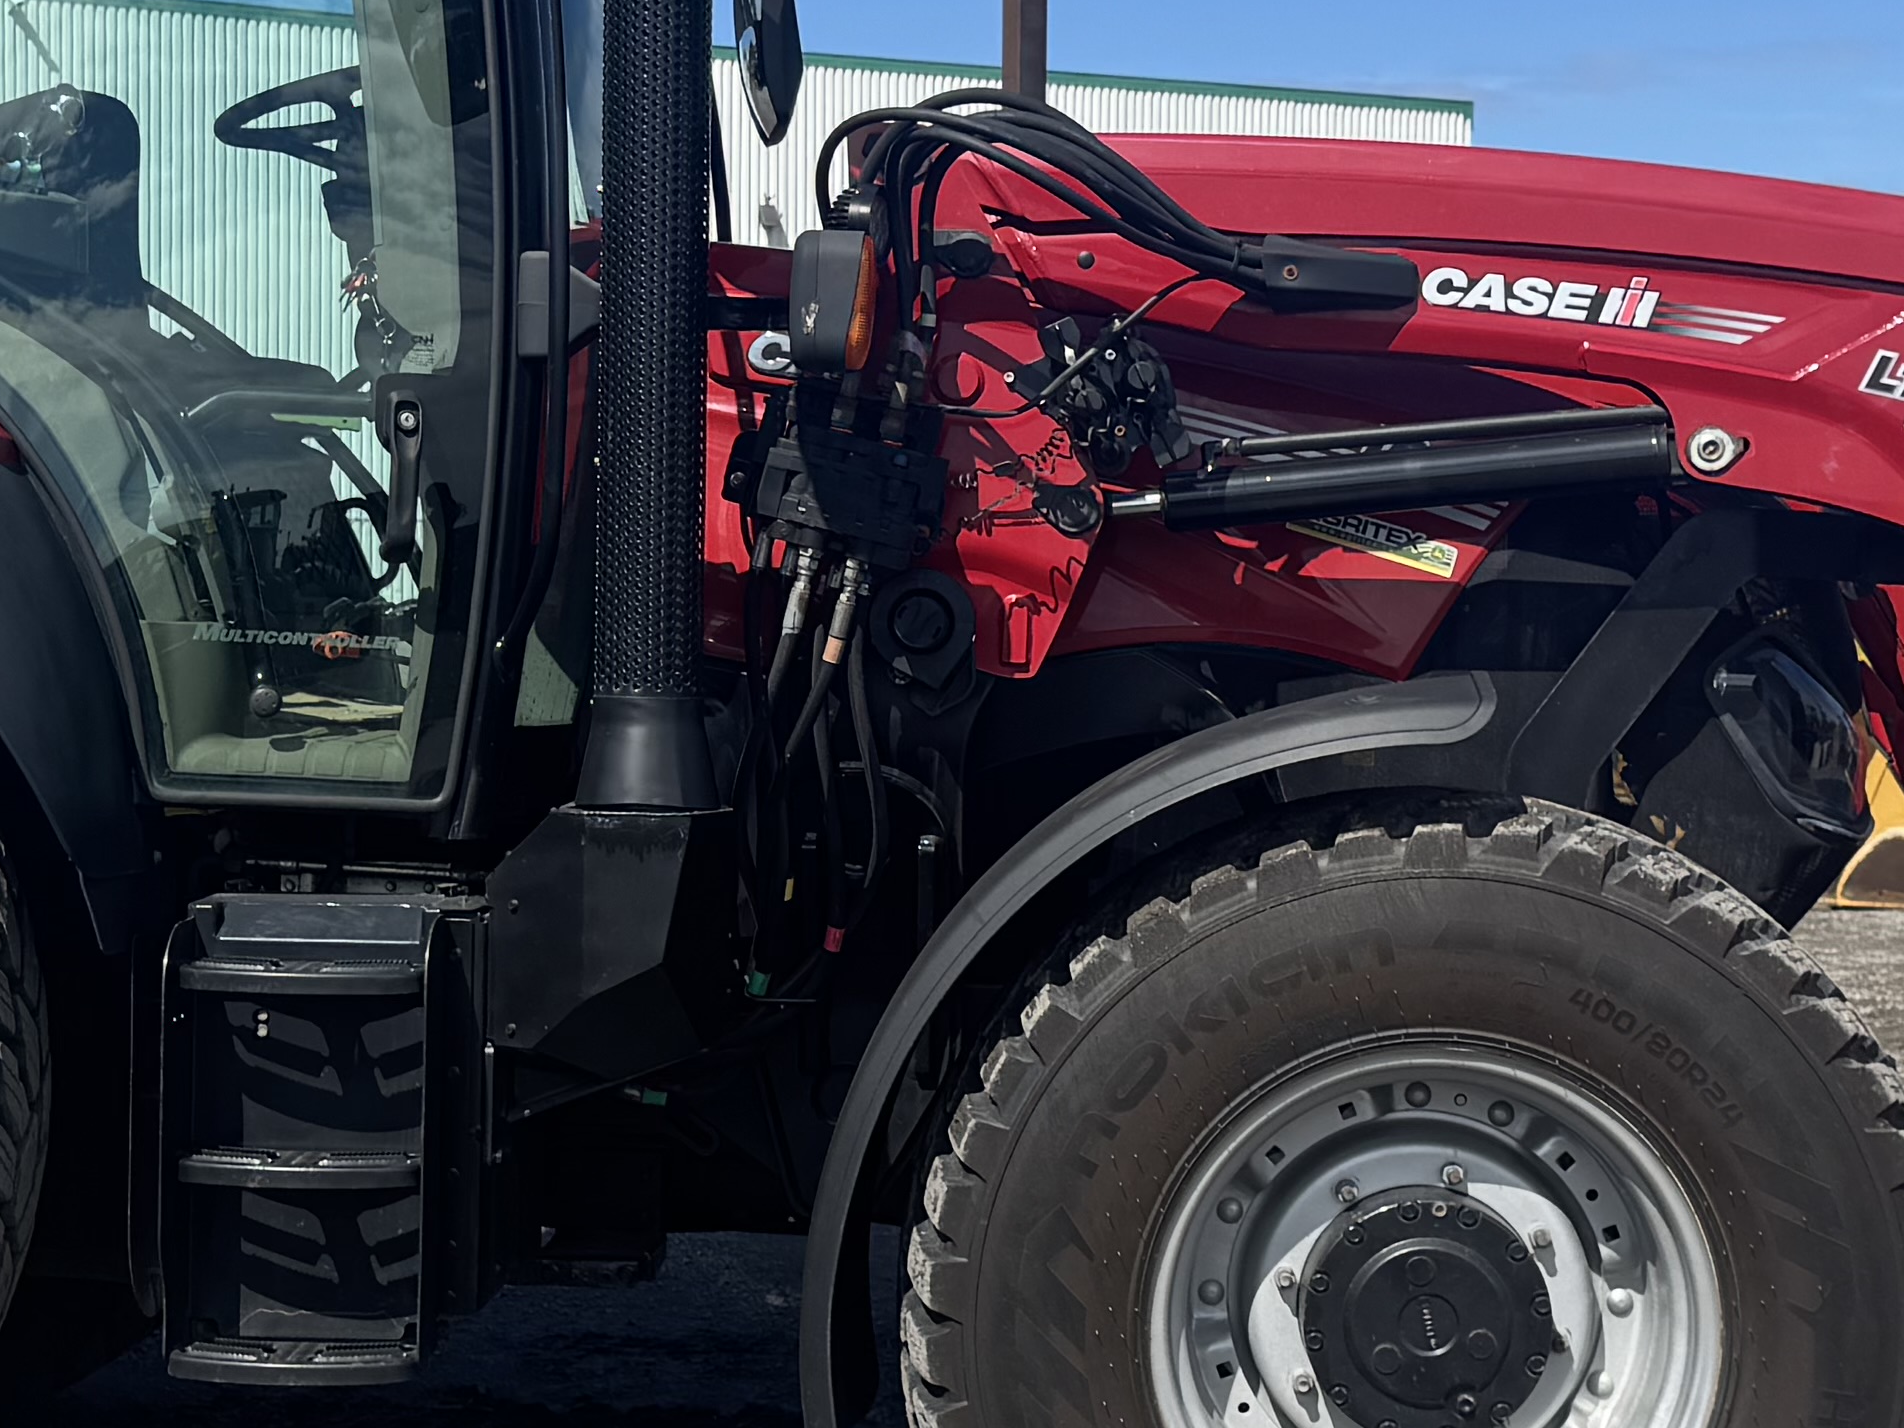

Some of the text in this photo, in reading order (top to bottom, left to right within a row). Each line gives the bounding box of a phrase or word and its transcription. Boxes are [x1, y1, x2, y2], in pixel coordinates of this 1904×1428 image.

[1421, 266, 1598, 322] CASE
[1314, 514, 1428, 552] GRITEX
[1568, 987, 1744, 1129] 400/80R24
